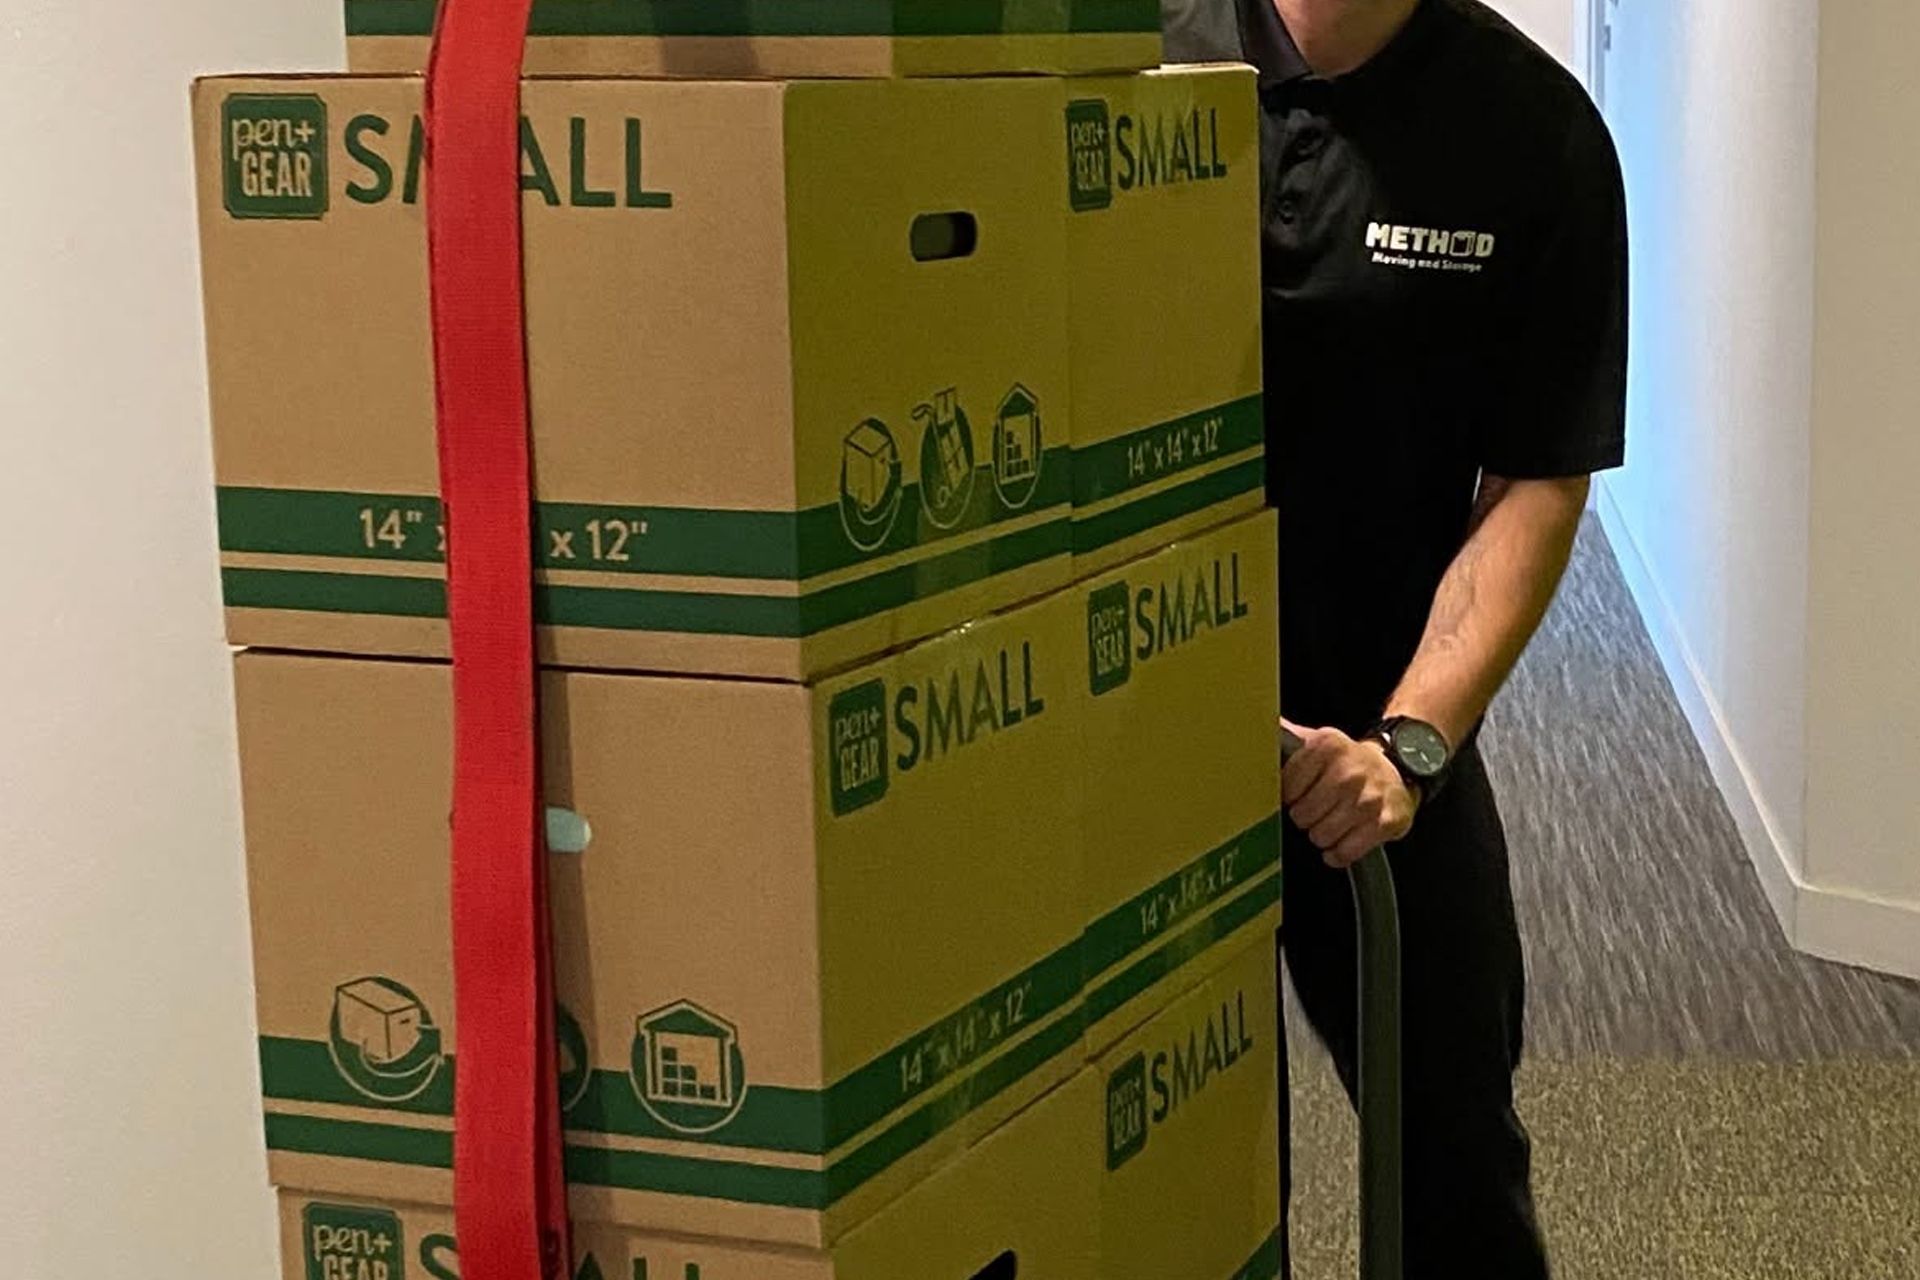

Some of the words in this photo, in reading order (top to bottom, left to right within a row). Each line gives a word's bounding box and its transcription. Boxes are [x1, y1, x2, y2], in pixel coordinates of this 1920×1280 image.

[232, 118, 316, 161] pen+
[344, 114, 672, 208] SALL
[1116, 108, 1227, 190] SMALL
[242, 151, 313, 197] GEAR
[1371, 251, 1417, 269] Moving
[1417, 259, 1440, 269] and
[1154, 446, 1164, 471] x
[1192, 433, 1202, 458] x
[359, 508, 424, 549] 14"
[550, 530, 576, 559] x
[585, 519, 649, 562] 12"
[1136, 552, 1248, 661] SMALL
[894, 640, 1045, 771] SMALL
[1151, 989, 1253, 1123] SMALL
